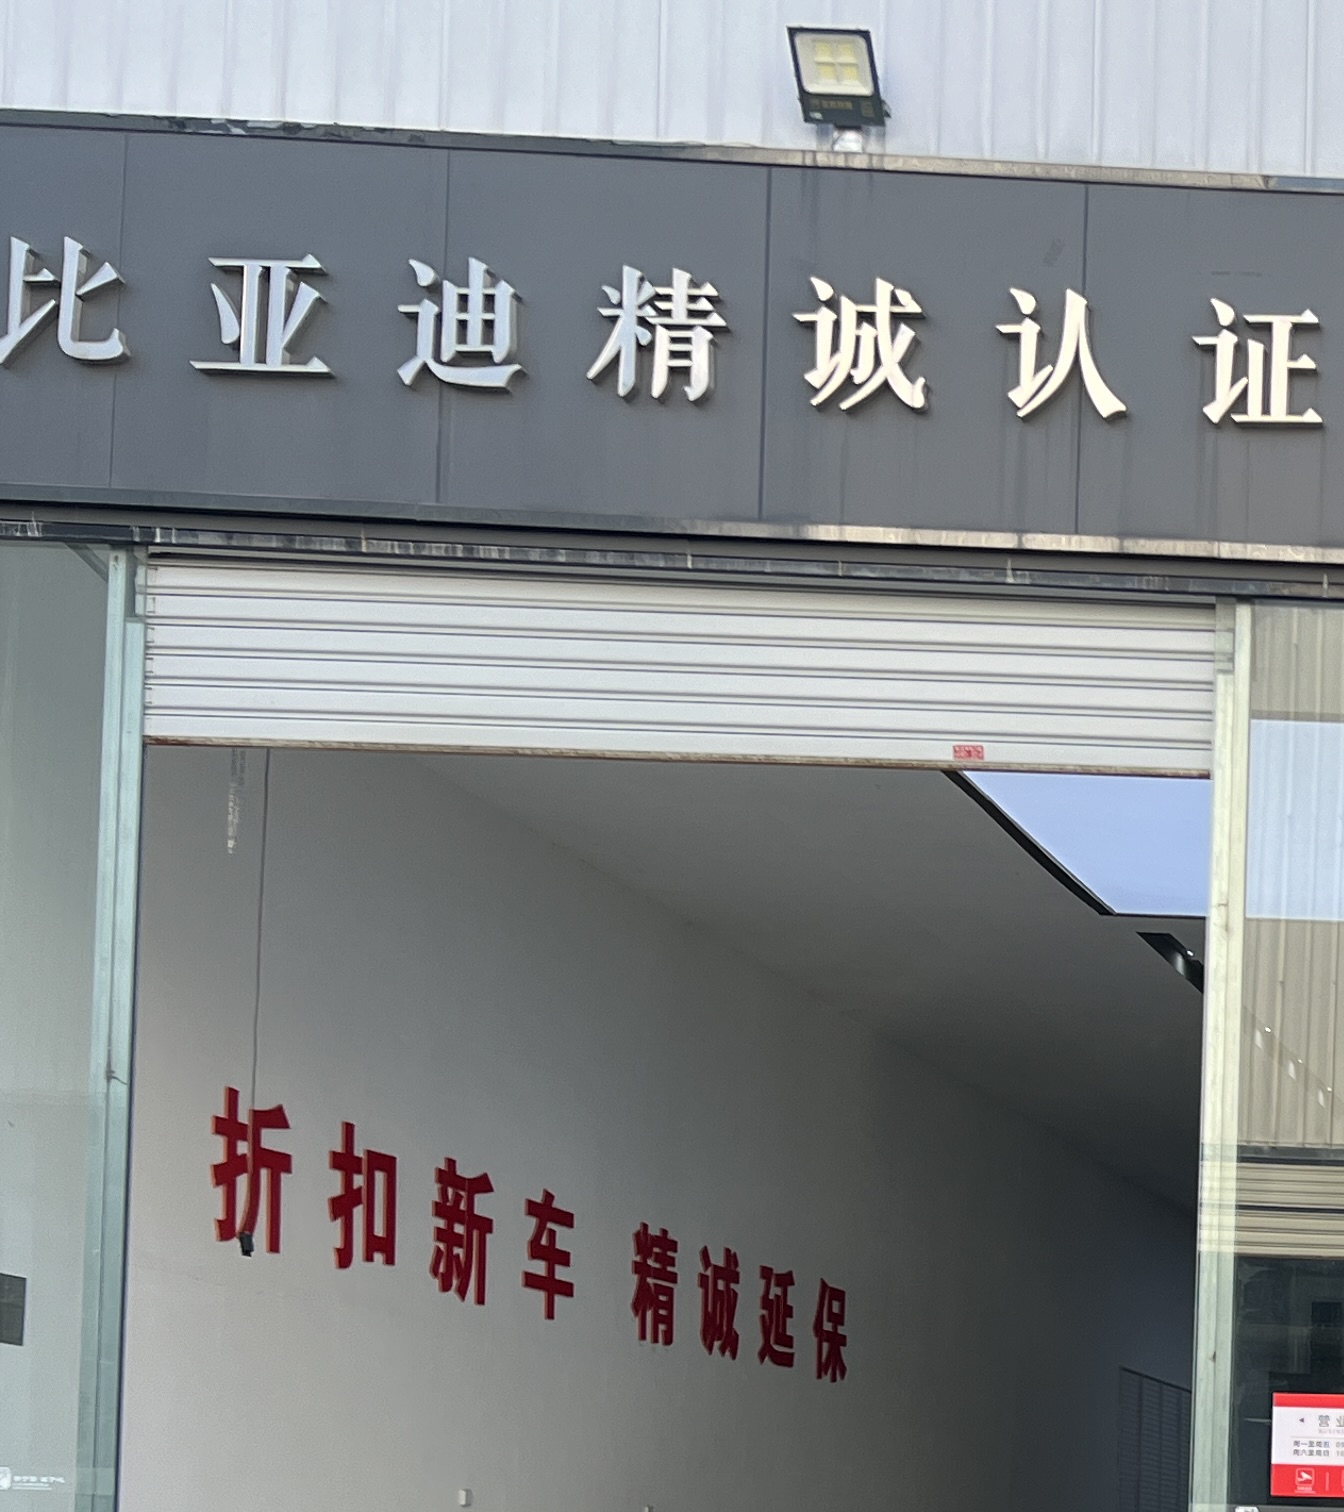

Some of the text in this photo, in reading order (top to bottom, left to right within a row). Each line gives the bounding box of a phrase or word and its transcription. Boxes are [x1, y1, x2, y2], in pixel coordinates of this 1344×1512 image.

[210, 1086, 848, 1383] 折扣新车 精诚延保
